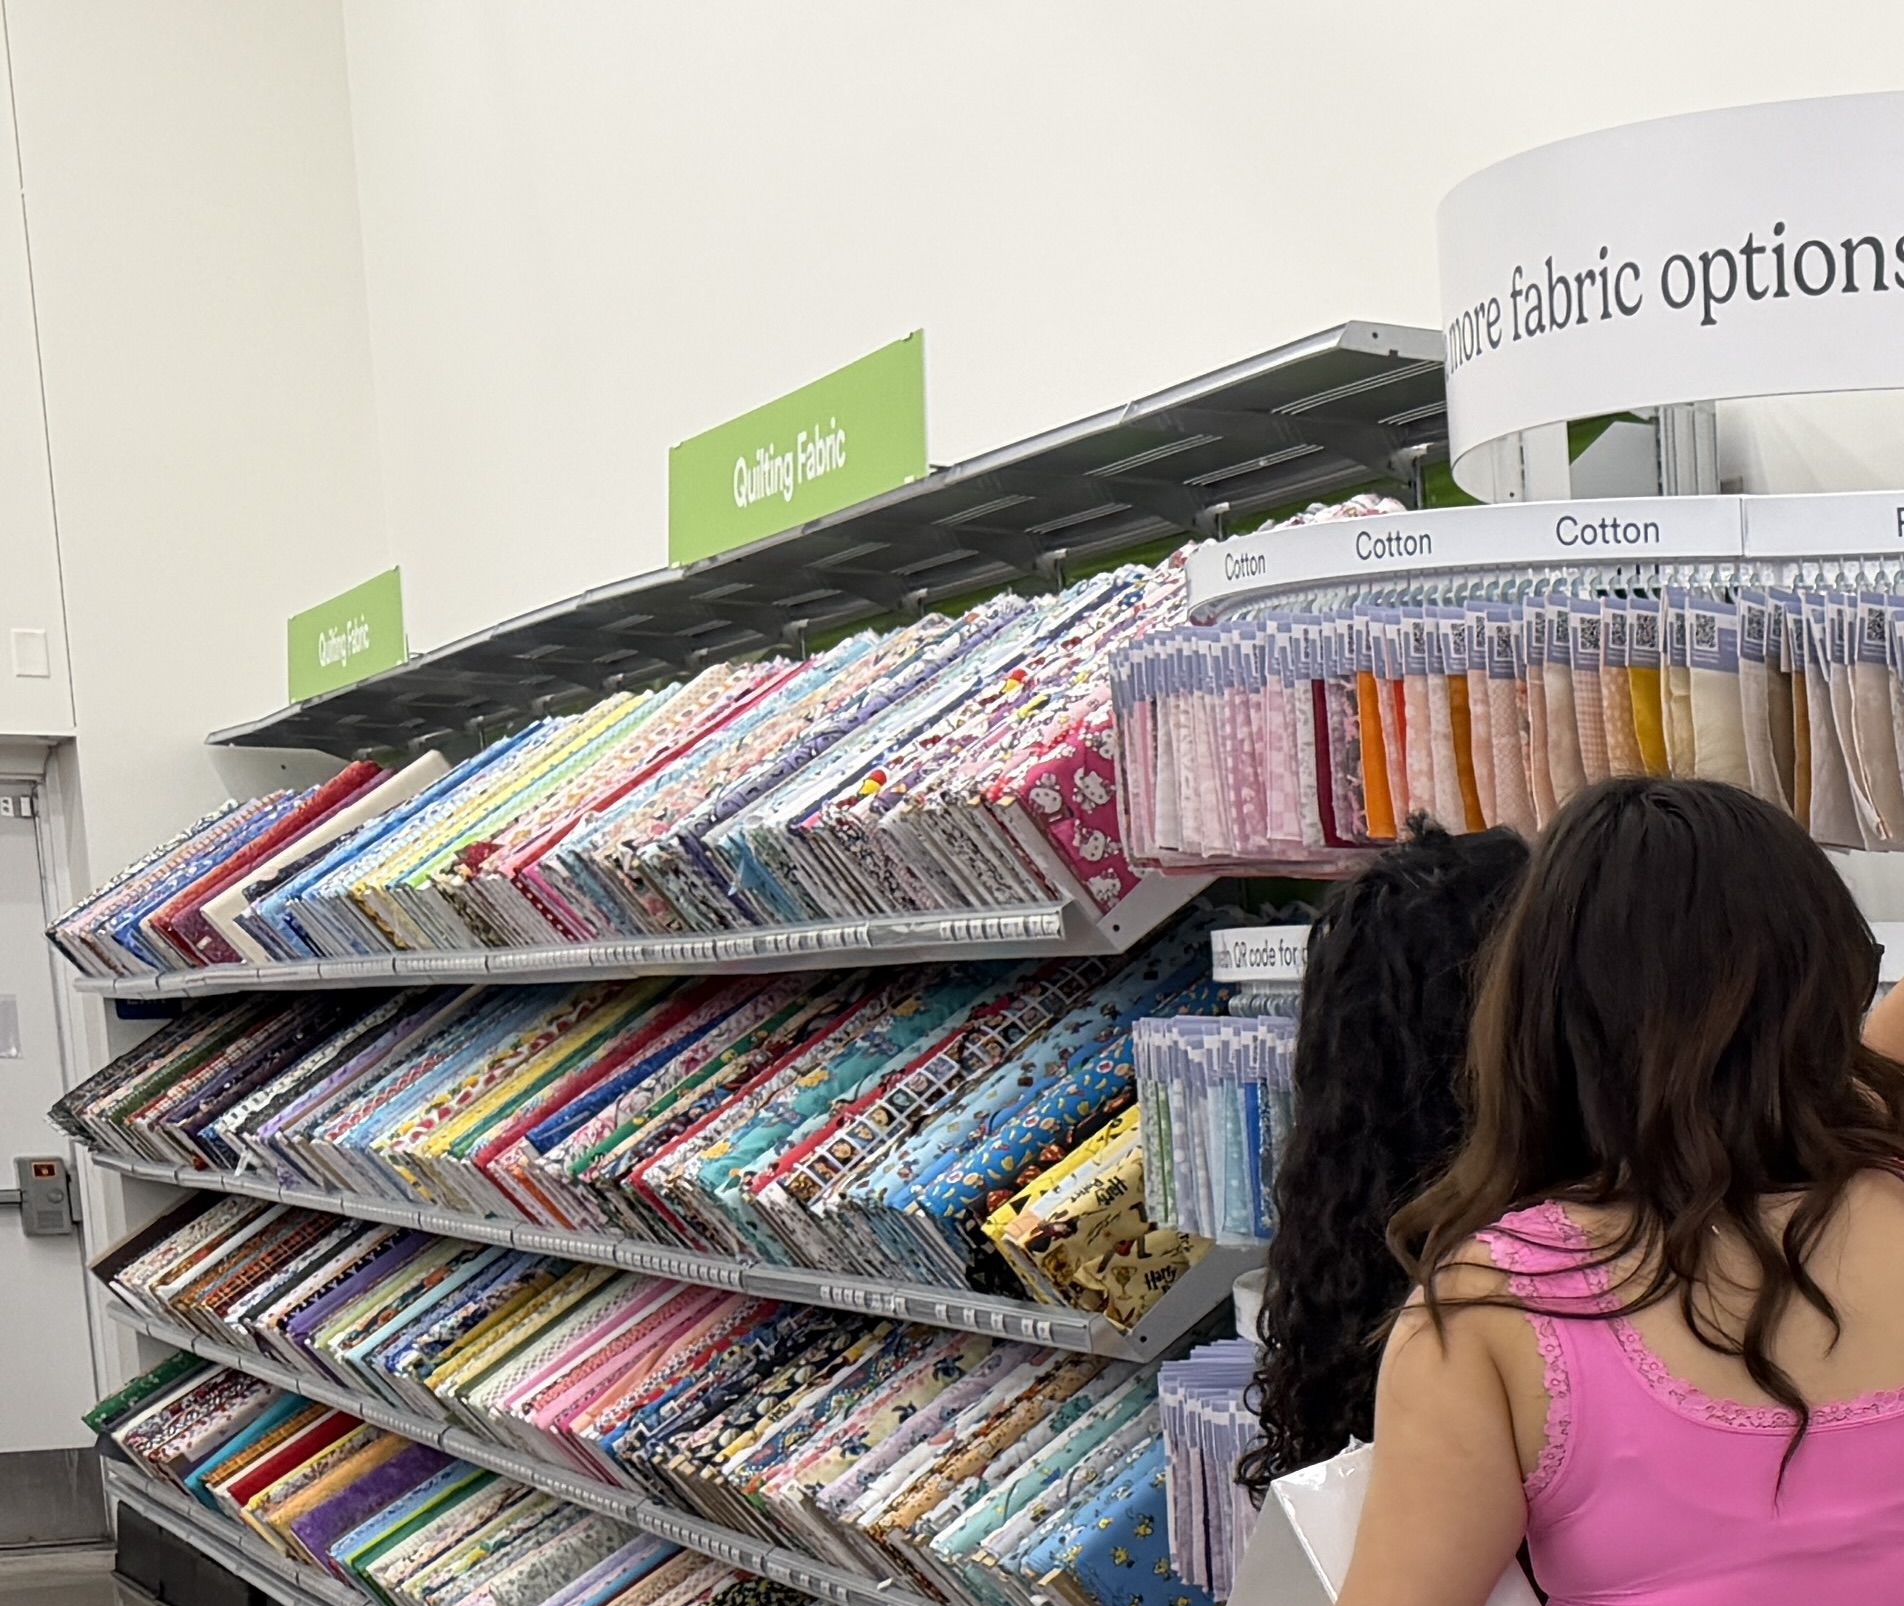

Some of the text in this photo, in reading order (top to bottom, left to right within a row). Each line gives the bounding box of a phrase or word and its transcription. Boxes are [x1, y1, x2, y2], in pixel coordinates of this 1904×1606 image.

[1445, 296, 1503, 381] more
[1509, 245, 1643, 342] fabric
[733, 416, 846, 508] Quilting Fabric
[1355, 530, 1432, 561] Cotton
[1555, 515, 1660, 546] Cotton
[1224, 552, 1266, 581] Cotton
[318, 613, 370, 668] Quilting Fabric
[1249, 939, 1276, 968] code
